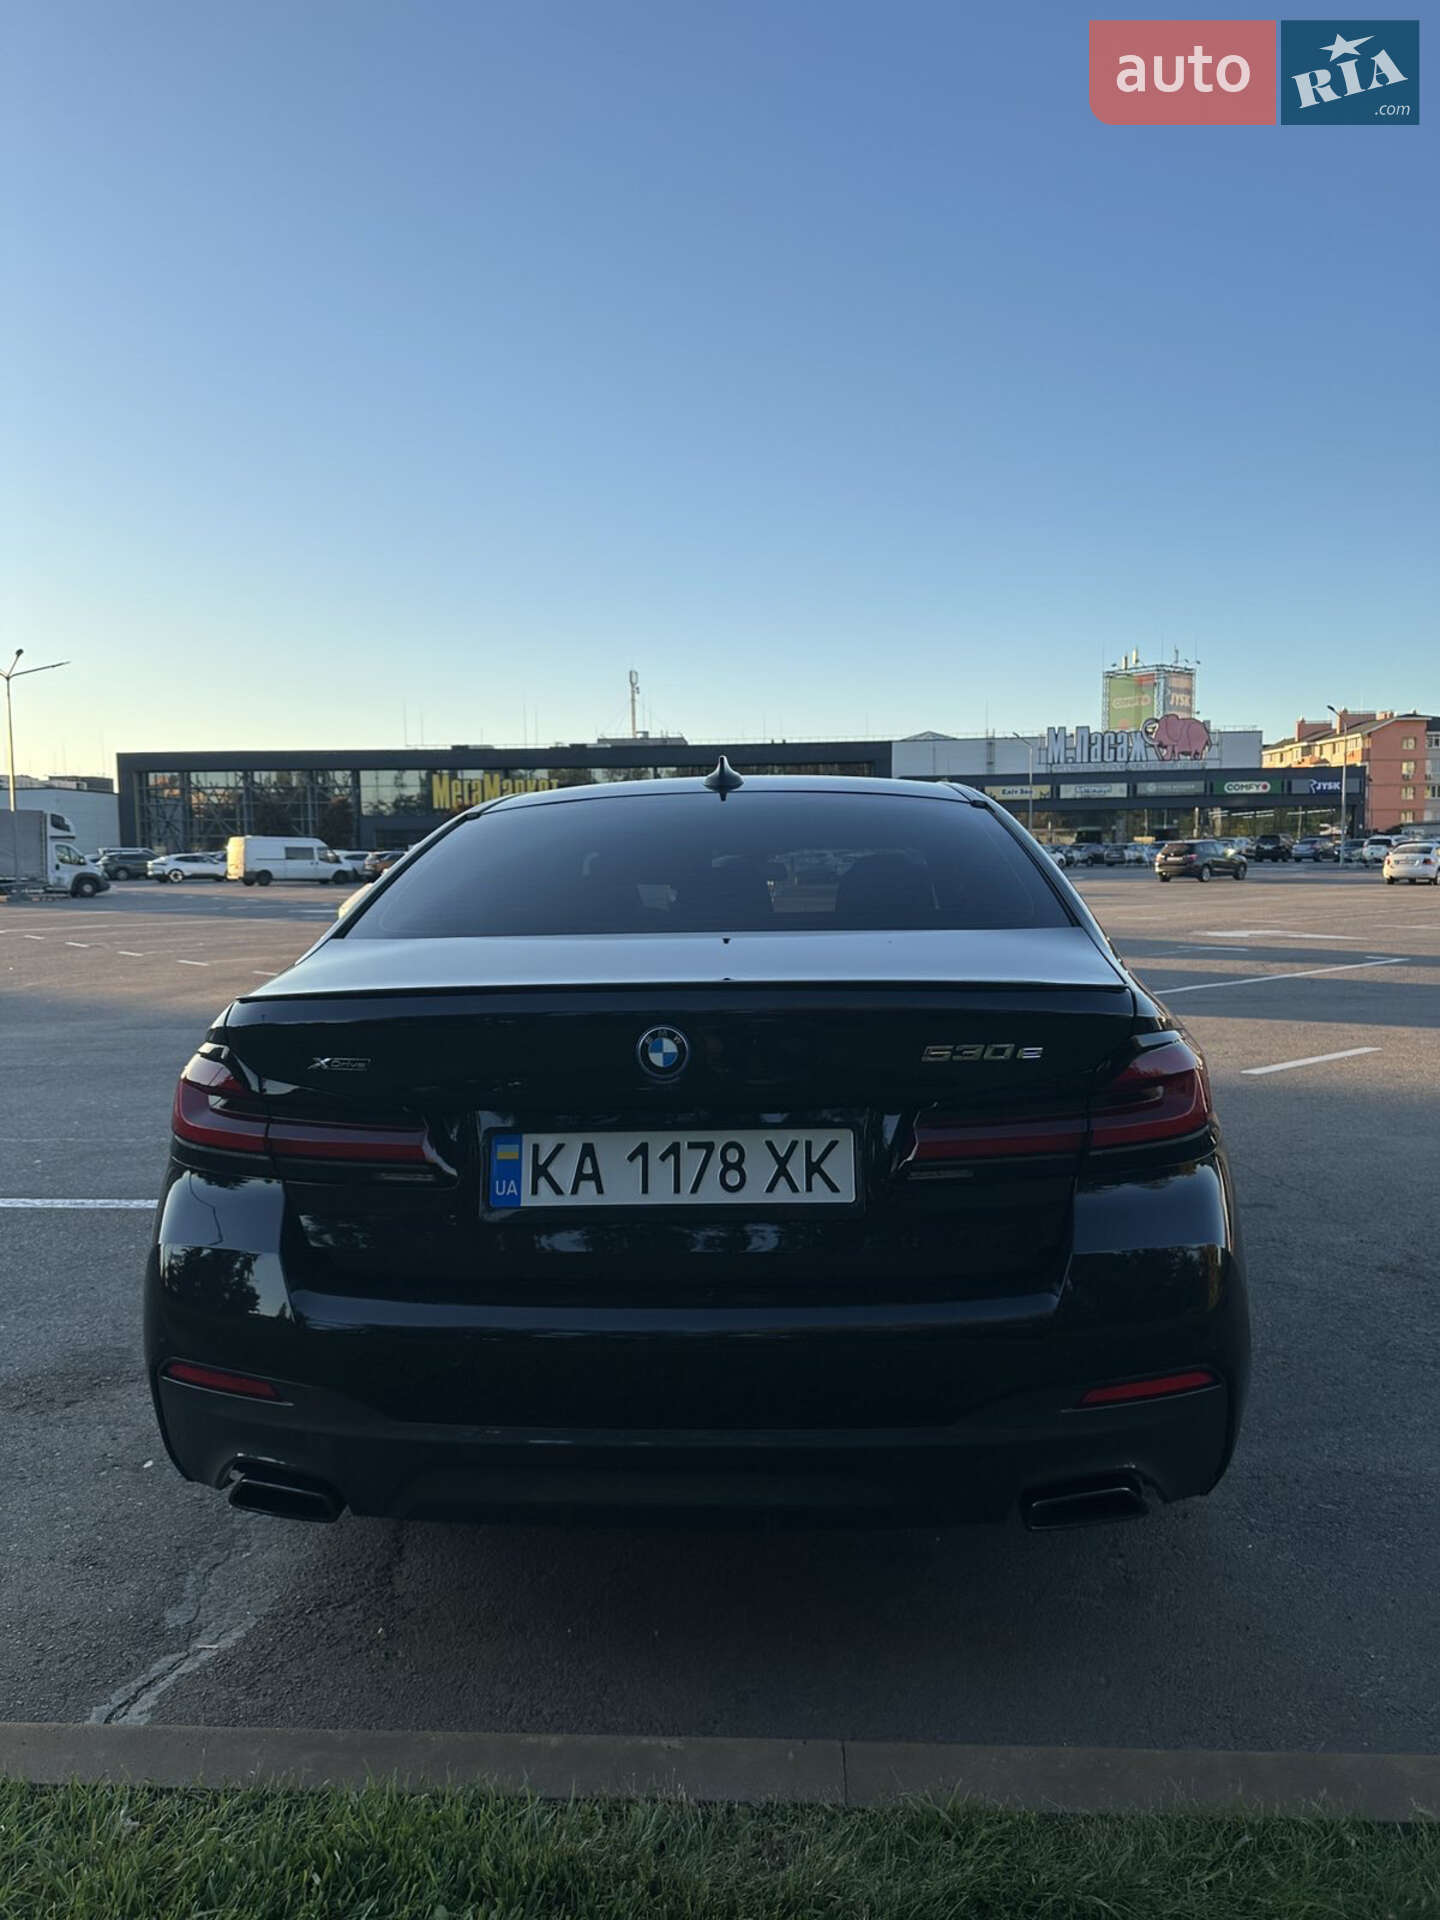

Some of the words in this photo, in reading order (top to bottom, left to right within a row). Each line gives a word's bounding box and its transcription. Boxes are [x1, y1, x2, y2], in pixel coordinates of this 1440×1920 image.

[1226, 782, 1261, 792] COMFY
[1315, 780, 1341, 791] JYSK
[530, 1142, 604, 1196] KA
[626, 1140, 747, 1195] 1178
[764, 1139, 841, 1194] XK
[495, 1180, 519, 1197] UA
